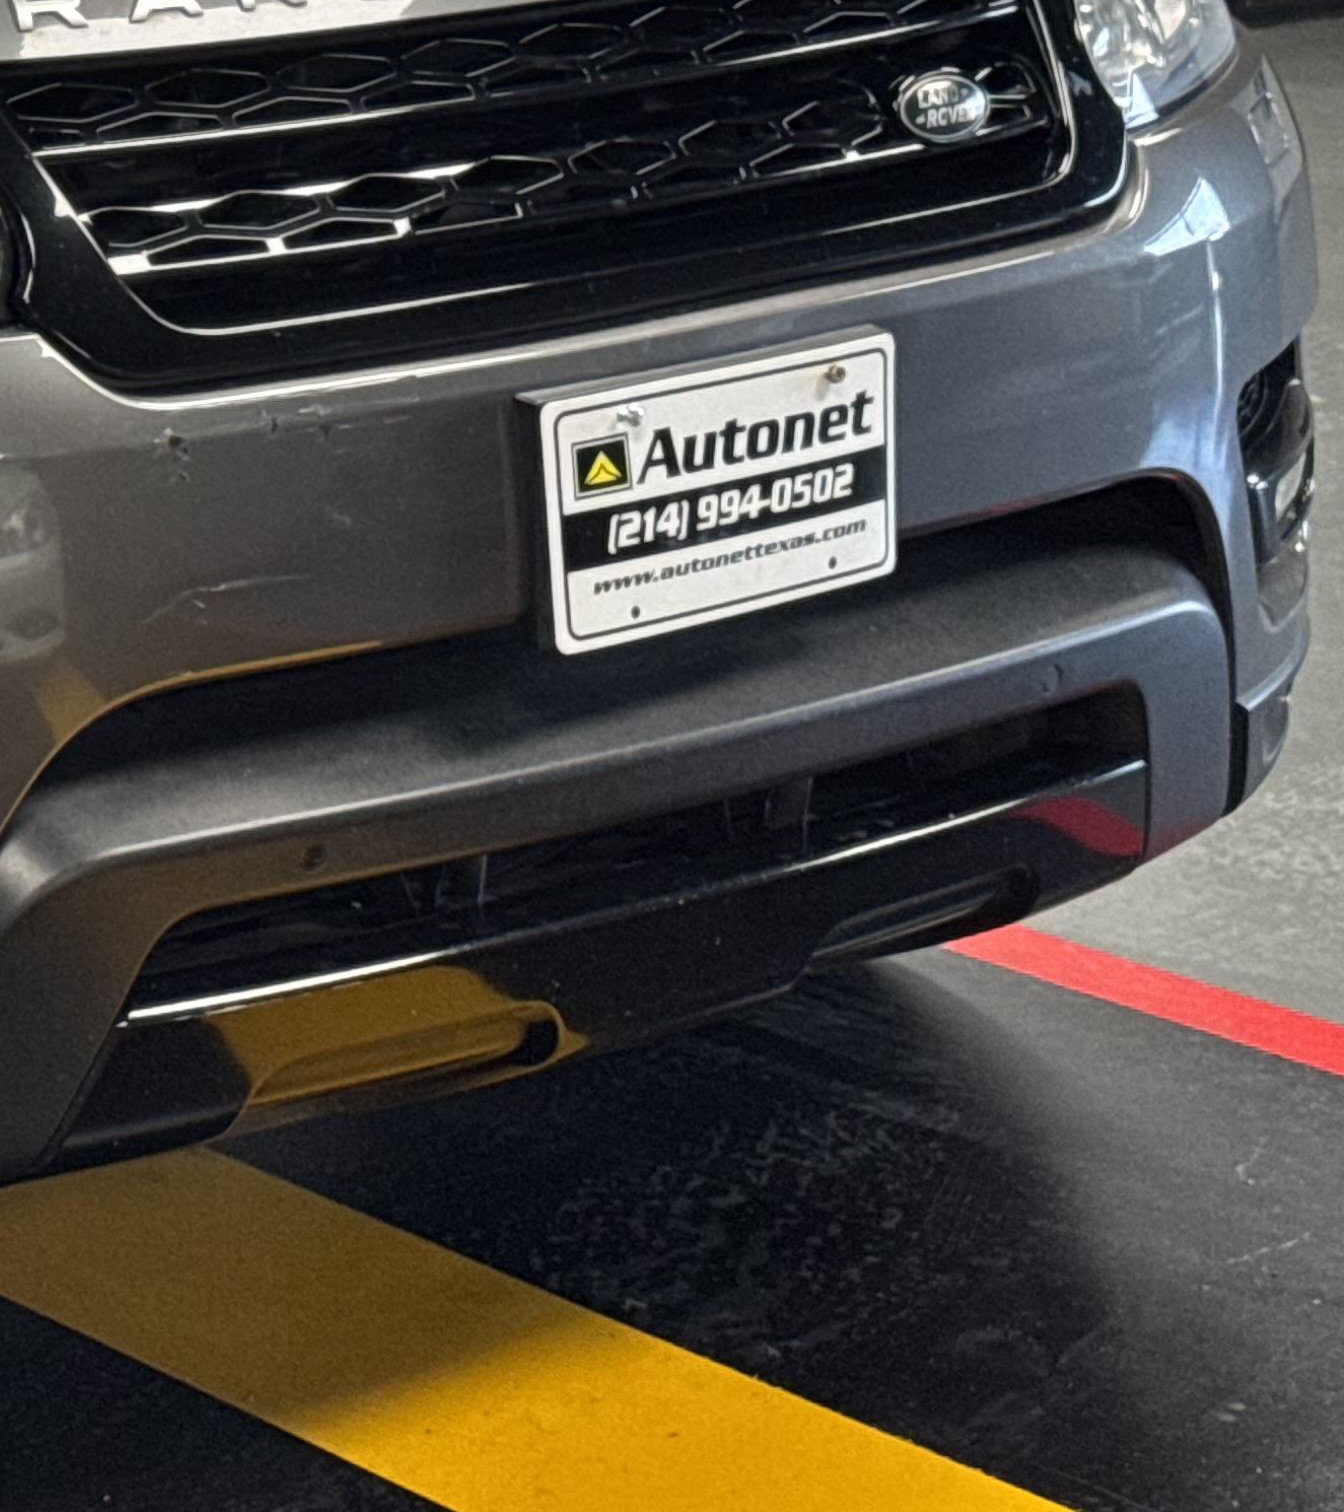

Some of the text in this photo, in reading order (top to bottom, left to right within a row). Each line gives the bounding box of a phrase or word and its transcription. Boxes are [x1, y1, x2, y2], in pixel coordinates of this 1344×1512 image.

[917, 83, 960, 109] LAND
[637, 390, 874, 485] Autonet
[608, 463, 854, 554] (214) 994-0502
[593, 518, 866, 595] www.autonettexas.com
